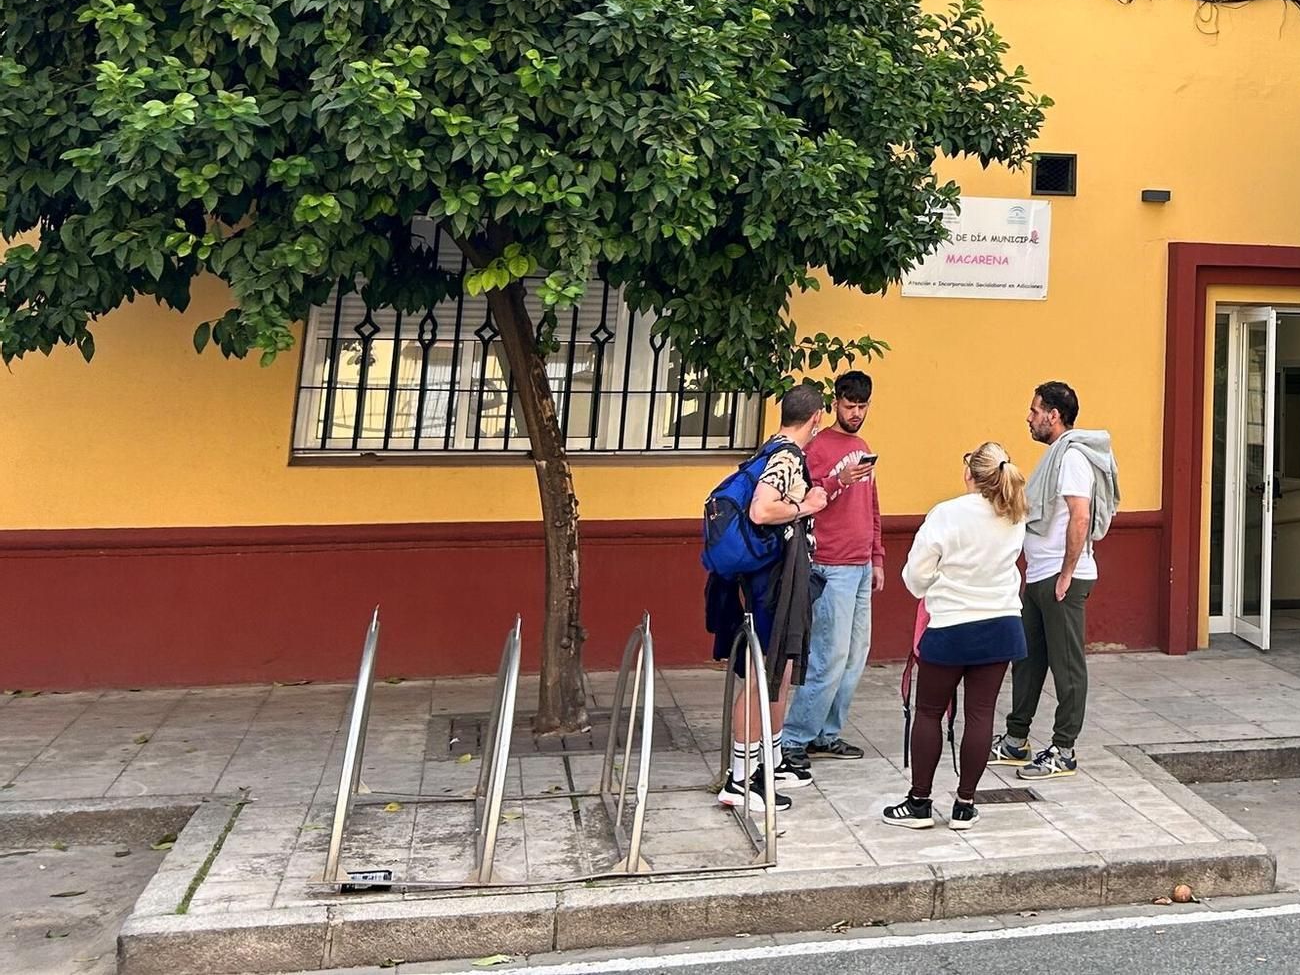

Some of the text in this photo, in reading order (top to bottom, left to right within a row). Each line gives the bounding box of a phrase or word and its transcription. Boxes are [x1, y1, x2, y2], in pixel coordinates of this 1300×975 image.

[956, 233, 968, 242] DE
[970, 233, 987, 242] DÍA
[945, 254, 1009, 265] MACARENA
